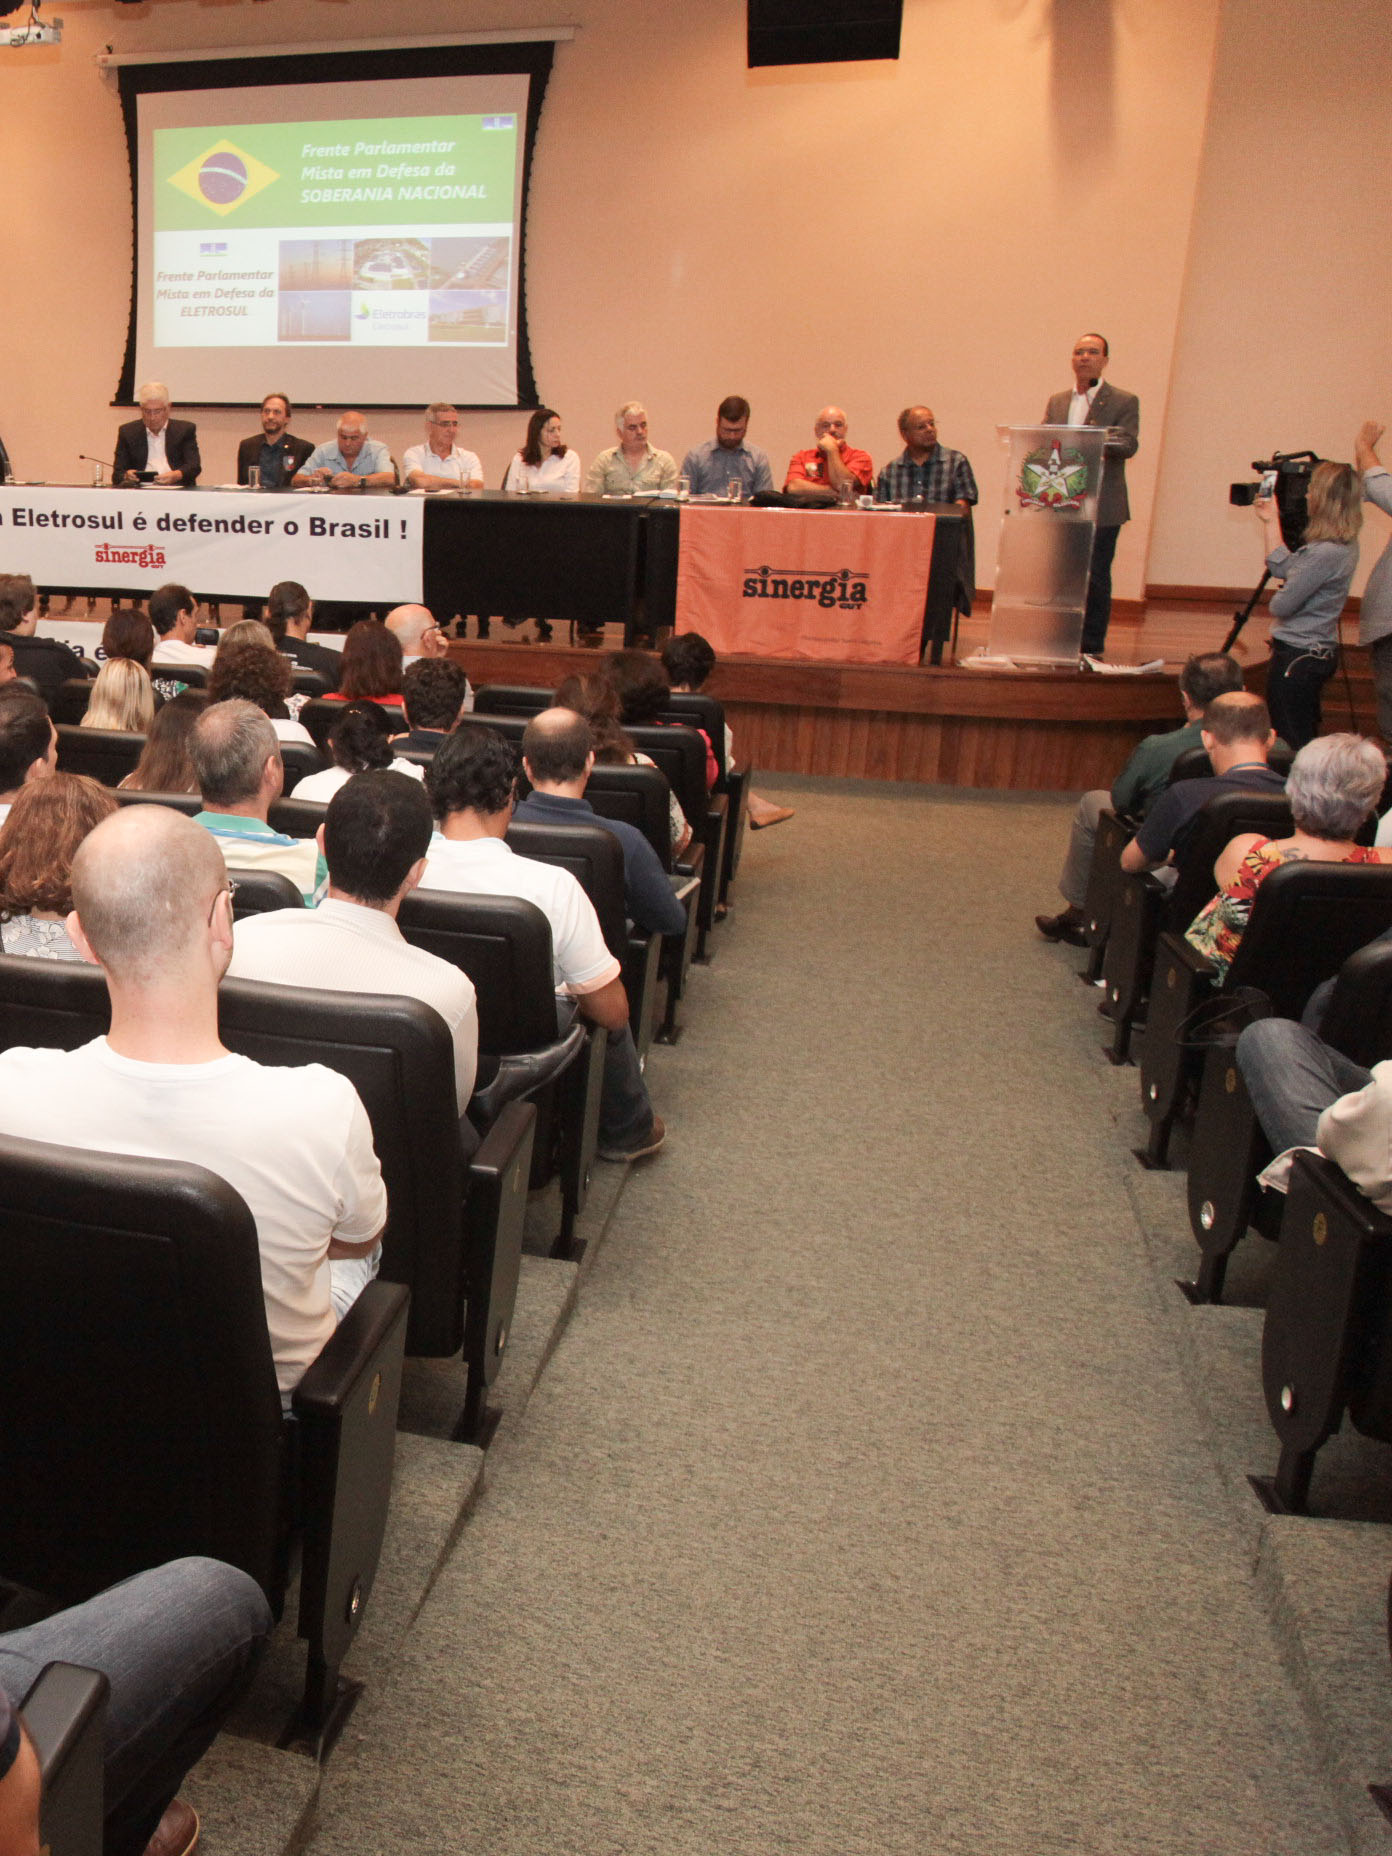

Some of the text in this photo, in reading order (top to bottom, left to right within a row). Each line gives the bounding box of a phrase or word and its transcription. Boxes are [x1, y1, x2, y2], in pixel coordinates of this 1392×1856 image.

[301, 140, 456, 158] Frente Parlamentar
[301, 161, 456, 180] Mista em Defesa da
[300, 184, 488, 203] SOBERANIA NACIONAL
[156, 270, 274, 282] Frente Parlamentar
[156, 286, 274, 300] Mista em Defesa da
[180, 305, 249, 318] ELETROSUL
[12, 508, 123, 530] Eletrosul
[132, 512, 147, 530] é
[156, 513, 274, 535] defender
[283, 520, 299, 536] o
[309, 516, 390, 539] Brasil
[400, 519, 408, 540] !
[95, 550, 166, 568] sinergia
[743, 577, 868, 608] sinergia
